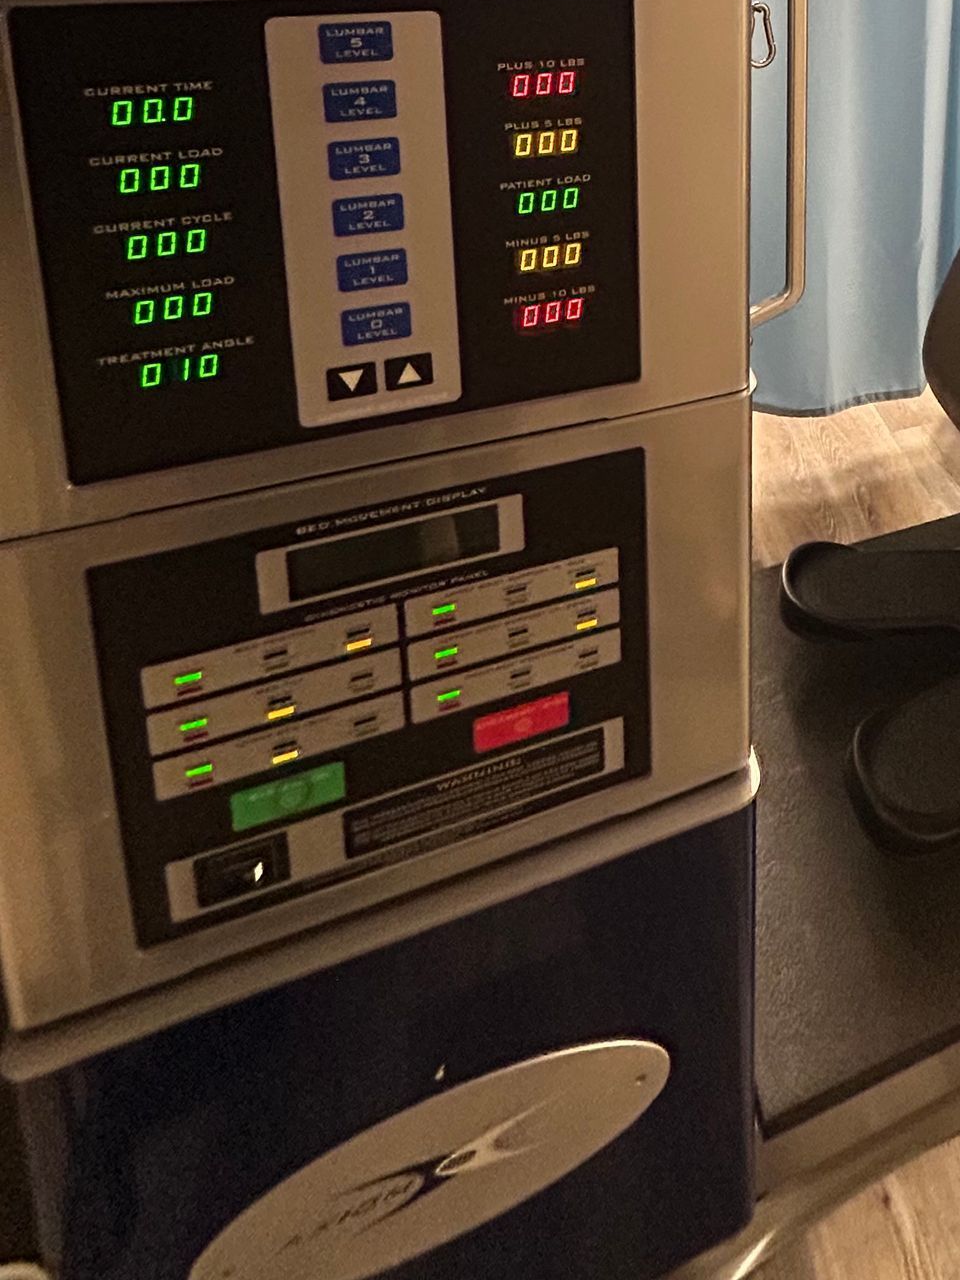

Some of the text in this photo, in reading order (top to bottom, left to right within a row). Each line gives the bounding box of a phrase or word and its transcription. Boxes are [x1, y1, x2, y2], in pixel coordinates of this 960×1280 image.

[325, 26, 384, 37] LUMBAR
[350, 37, 363, 48] 5
[335, 49, 379, 58] LEVEL
[497, 57, 585, 71] PLUS 10 LBS
[84, 80, 214, 97] CURRENT TIME
[331, 85, 388, 96] LUMBAR
[512, 71, 575, 97] 000
[353, 96, 367, 106] 4
[340, 107, 383, 117] LEVEL
[504, 116, 583, 131] PLUS 5 LBS
[335, 142, 392, 155] LUMBAR
[515, 129, 577, 156] 000
[89, 147, 224, 167] CURRENT LOAD
[358, 153, 370, 164] 3
[344, 164, 387, 175] LEVEL
[120, 163, 200, 194] 000
[500, 173, 591, 190] PATIENT LOAD
[339, 198, 396, 212] LUMBAR
[518, 187, 579, 214] 000
[93, 211, 233, 234] CURRENT CYCLE
[362, 210, 375, 220] 2
[348, 220, 392, 231] LEVEL
[127, 229, 206, 260] 000
[505, 230, 590, 248] MINUS 5 LBS
[344, 253, 400, 268] LUMBAR
[520, 242, 582, 271] 000
[370, 266, 376, 275] 1
[105, 275, 235, 299] MAXIMUM LOAD
[352, 274, 394, 287] LEVEL
[503, 285, 596, 305] MINUS 10 LBS
[134, 292, 212, 325] 000
[348, 306, 404, 322] LUMBAR
[523, 298, 583, 327] 000
[370, 319, 383, 330] 0
[357, 328, 398, 340] LEVEL
[96, 335, 255, 366] TREATMENT ANGLE
[296, 486, 487, 536] BED MOVEMENT DISPLAY
